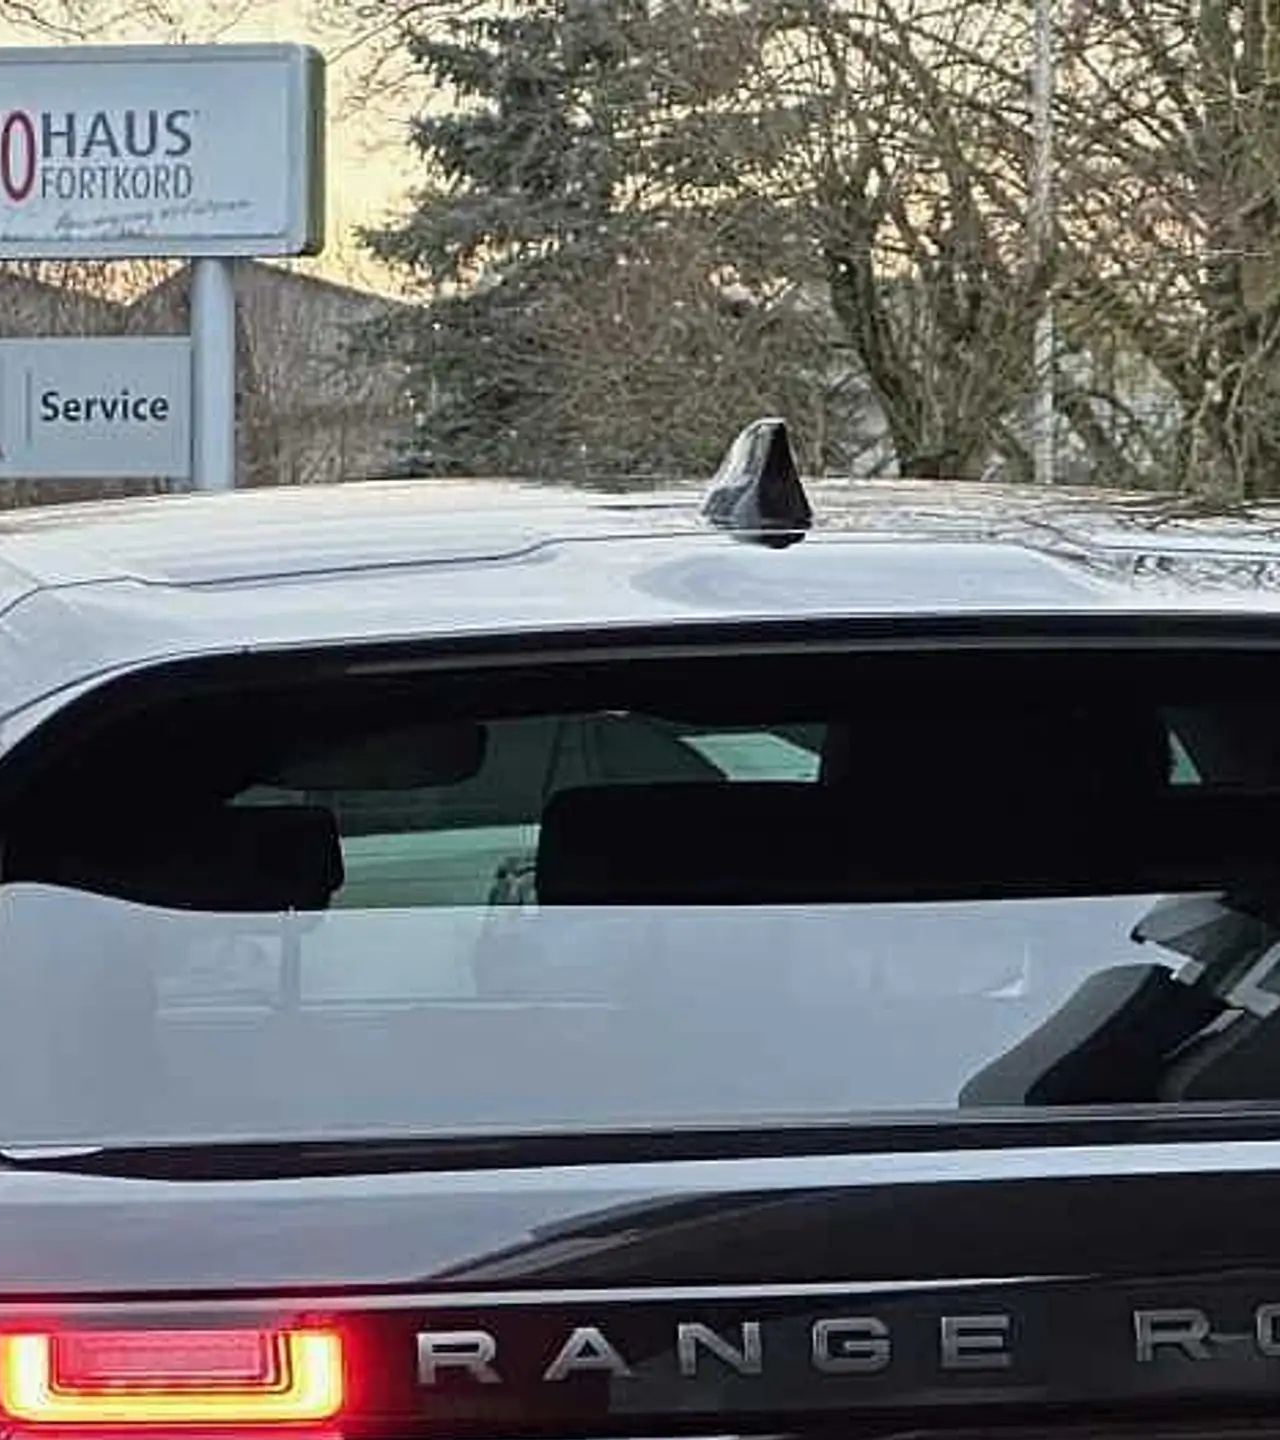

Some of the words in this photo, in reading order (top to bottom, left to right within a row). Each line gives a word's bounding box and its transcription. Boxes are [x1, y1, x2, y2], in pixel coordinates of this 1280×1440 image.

[40, 163, 193, 200] FORTKORD
[40, 390, 170, 423] Service
[416, 1313, 1014, 1385] RANGE
